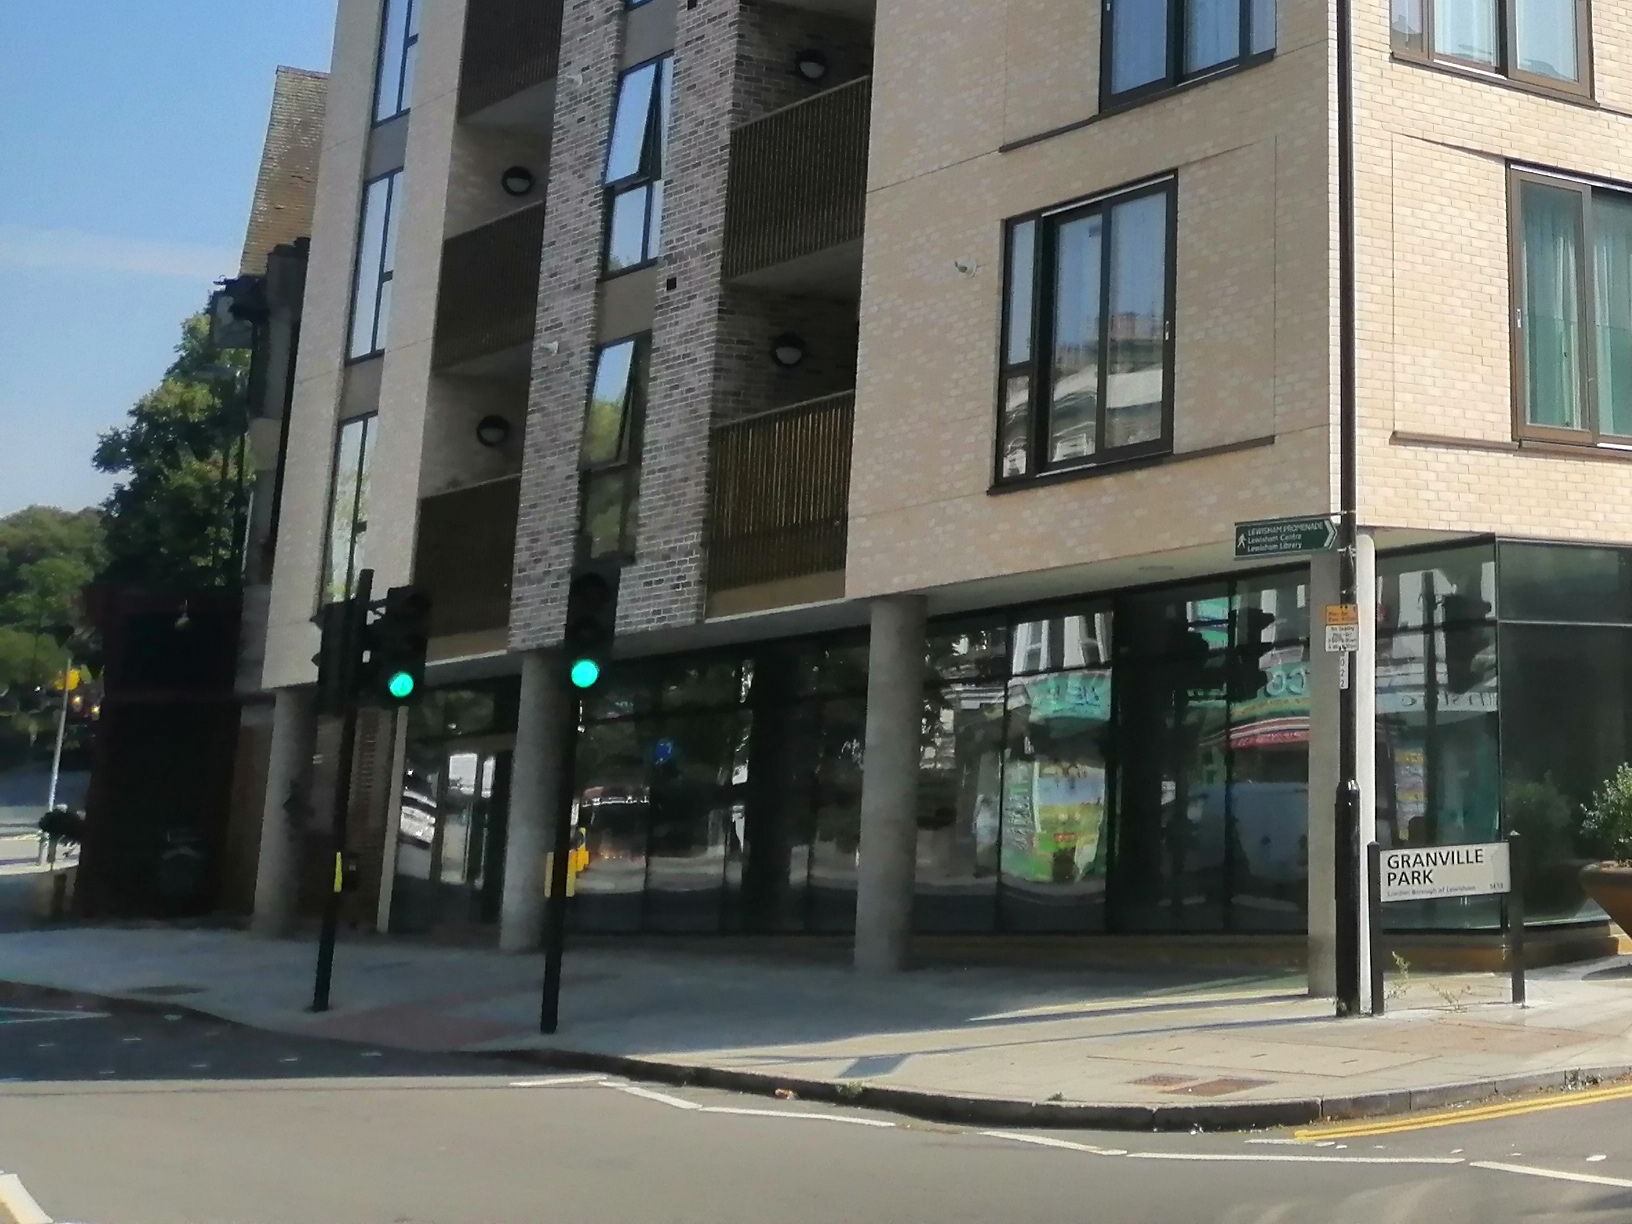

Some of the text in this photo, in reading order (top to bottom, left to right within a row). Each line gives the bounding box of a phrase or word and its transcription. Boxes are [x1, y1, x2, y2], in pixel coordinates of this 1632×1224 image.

[1247, 521, 1324, 537] LEWISHAM PROMENADE
[1247, 533, 1302, 544] Lewisham Centre
[1247, 542, 1303, 553] Lewisham Library
[1387, 848, 1484, 870] GRANVILLE
[1387, 869, 1434, 887] PARK
[1446, 885, 1476, 893] Lewisham
